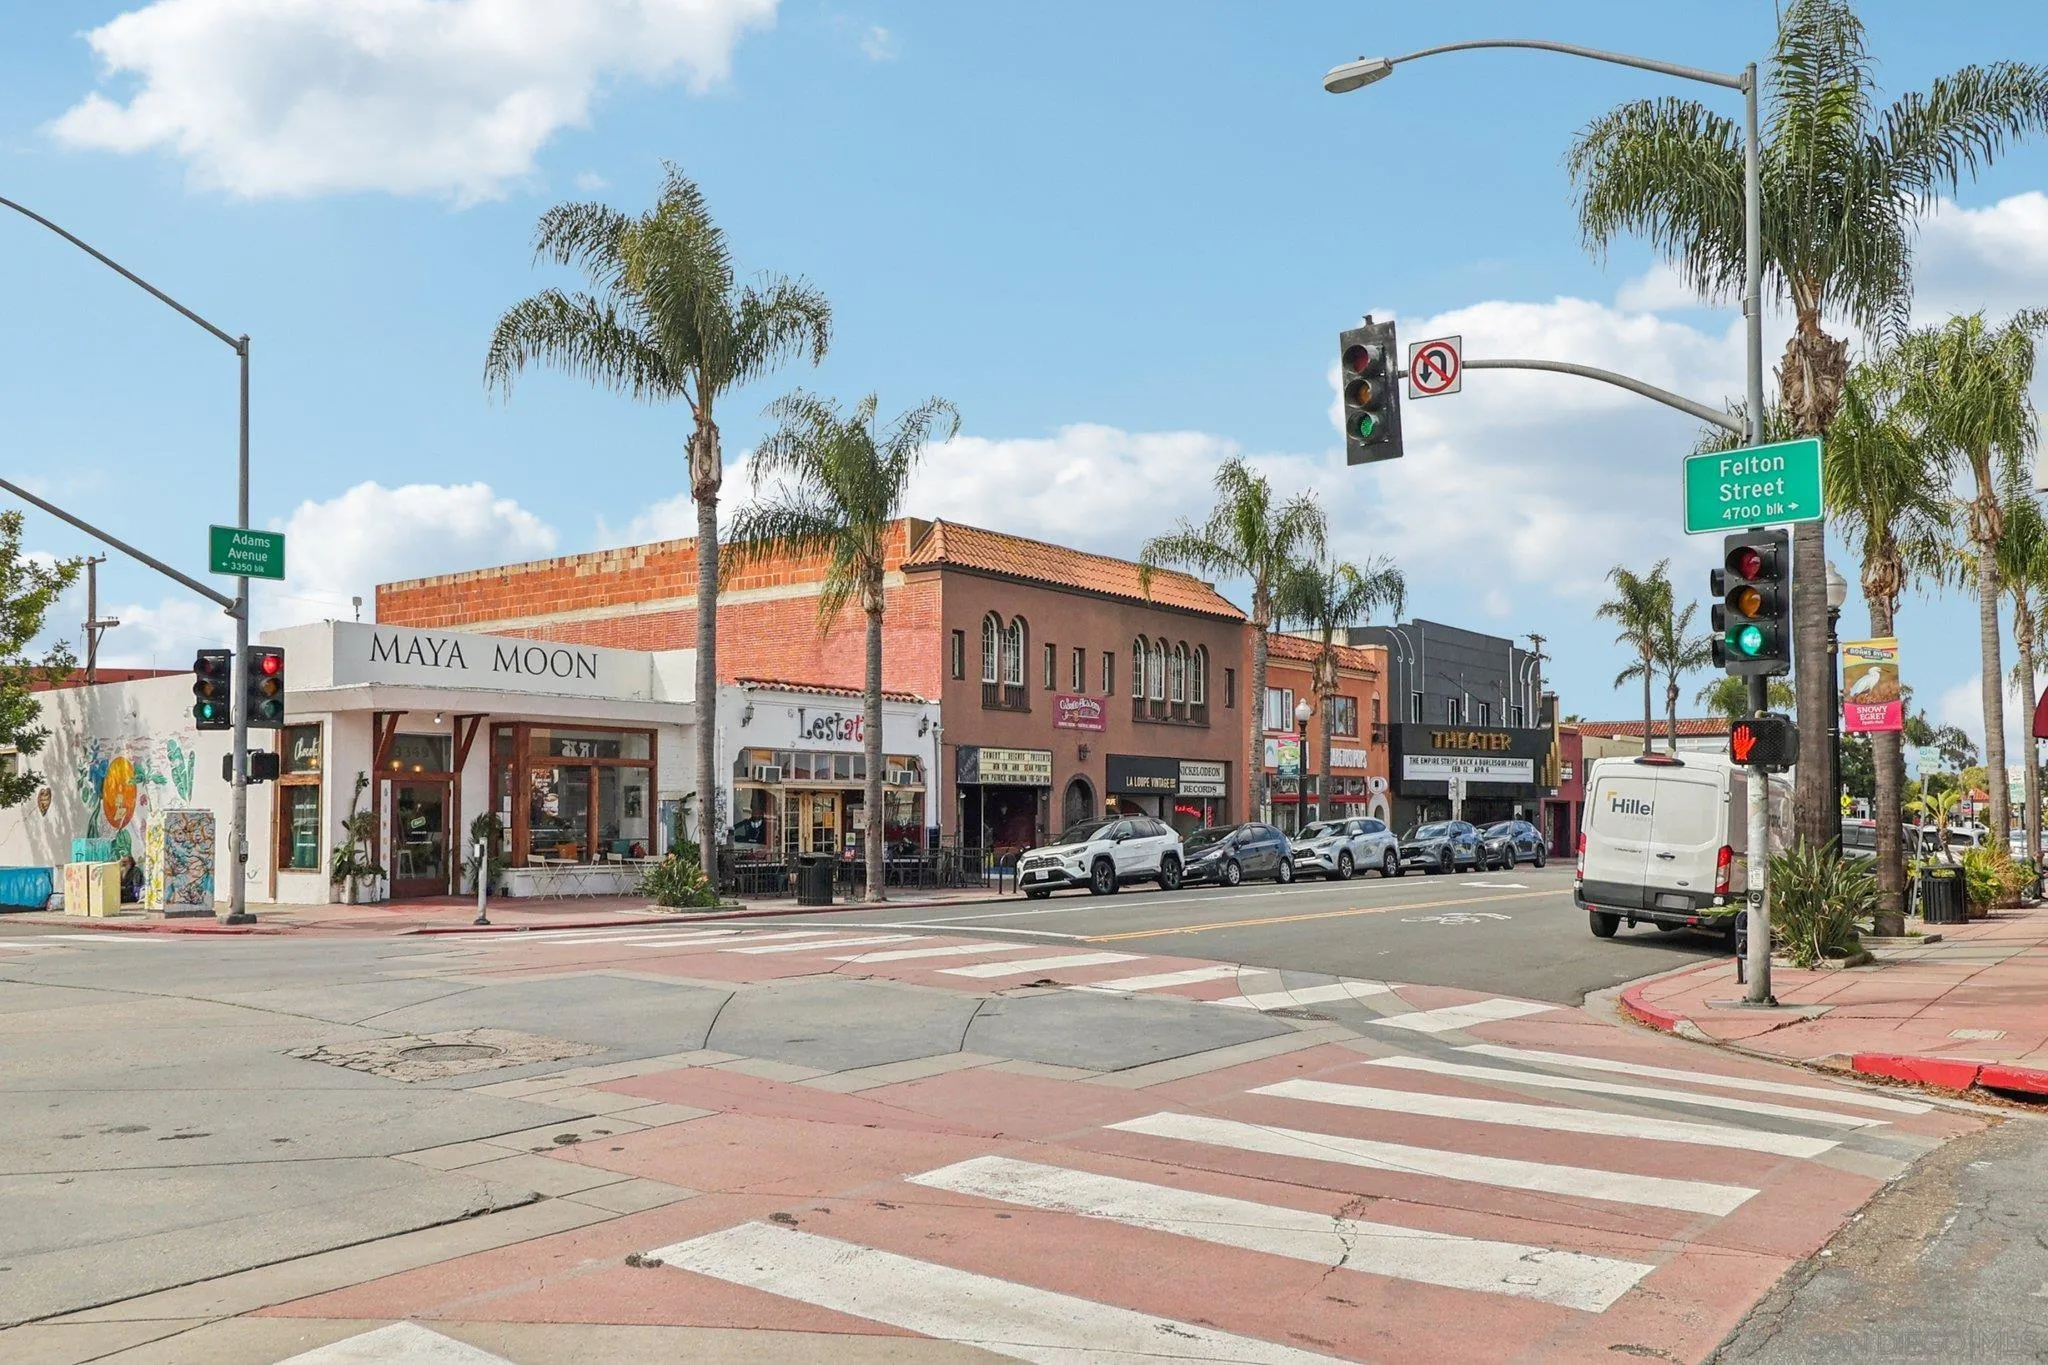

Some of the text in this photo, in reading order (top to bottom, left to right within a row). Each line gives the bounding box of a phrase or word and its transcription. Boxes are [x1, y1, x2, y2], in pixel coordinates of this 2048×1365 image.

[1720, 456, 1784, 477] Felton
[1720, 478, 1784, 501] Street
[1723, 503, 1784, 520] 4700 blk
[232, 533, 270, 547] Adams
[228, 548, 267, 561] Avenue
[231, 562, 252, 571] 3350
[369, 632, 598, 679] MAYA MOON
[1857, 706, 1887, 714] SNOWY
[1860, 713, 1885, 721] EGRET
[1432, 730, 1512, 750] THEATER
[1410, 757, 1419, 765] THE
[1441, 758, 1458, 766] STRIPS
[1479, 759, 1507, 767] BURLESQUE
[1126, 776, 1133, 787] LA
[1134, 777, 1150, 788] LOUPE
[1151, 777, 1169, 788] VINTAGE
[1183, 785, 1217, 793] RECORDS
[1612, 798, 1655, 815] Hillel
